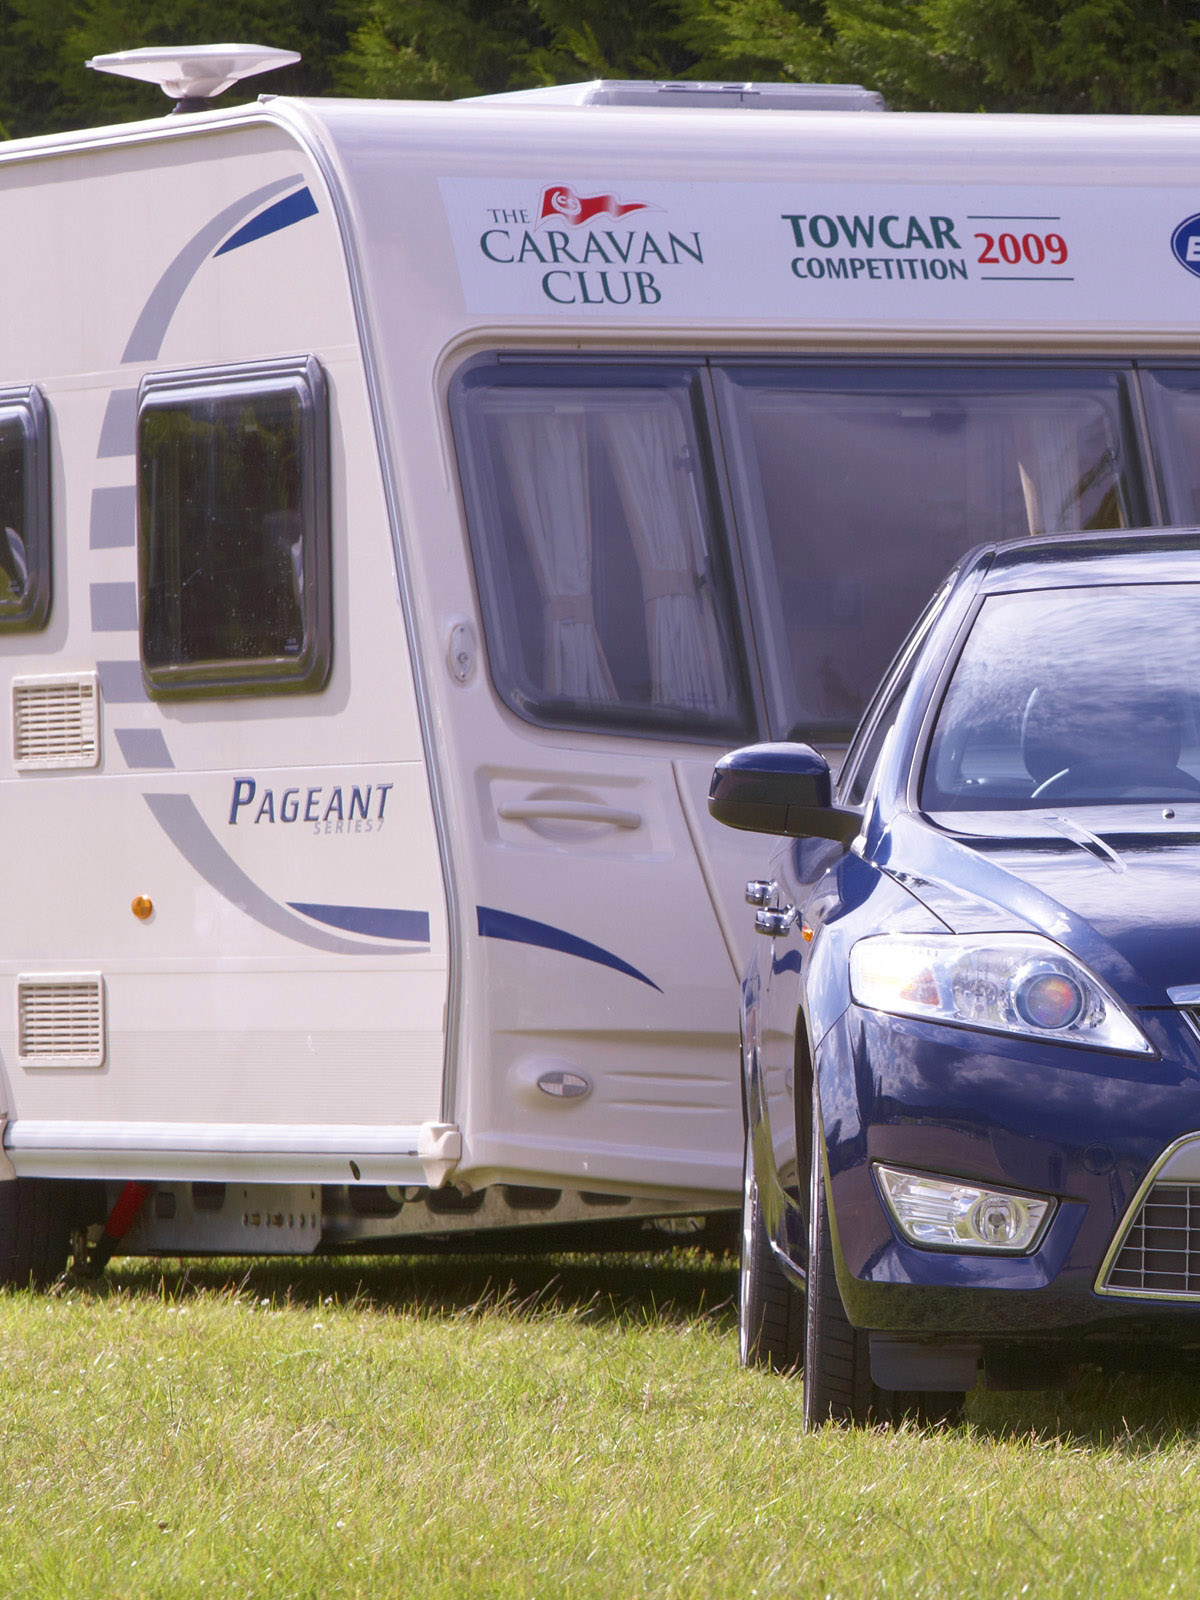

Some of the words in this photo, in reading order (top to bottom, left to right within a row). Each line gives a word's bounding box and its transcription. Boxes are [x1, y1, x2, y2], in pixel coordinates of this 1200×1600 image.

[487, 208, 530, 224] THE
[781, 214, 962, 249] TOWCAR
[480, 229, 704, 264] CARAVAN
[973, 232, 1068, 264] 2009
[791, 257, 968, 280] COMPETITION
[541, 270, 662, 304] CLUB
